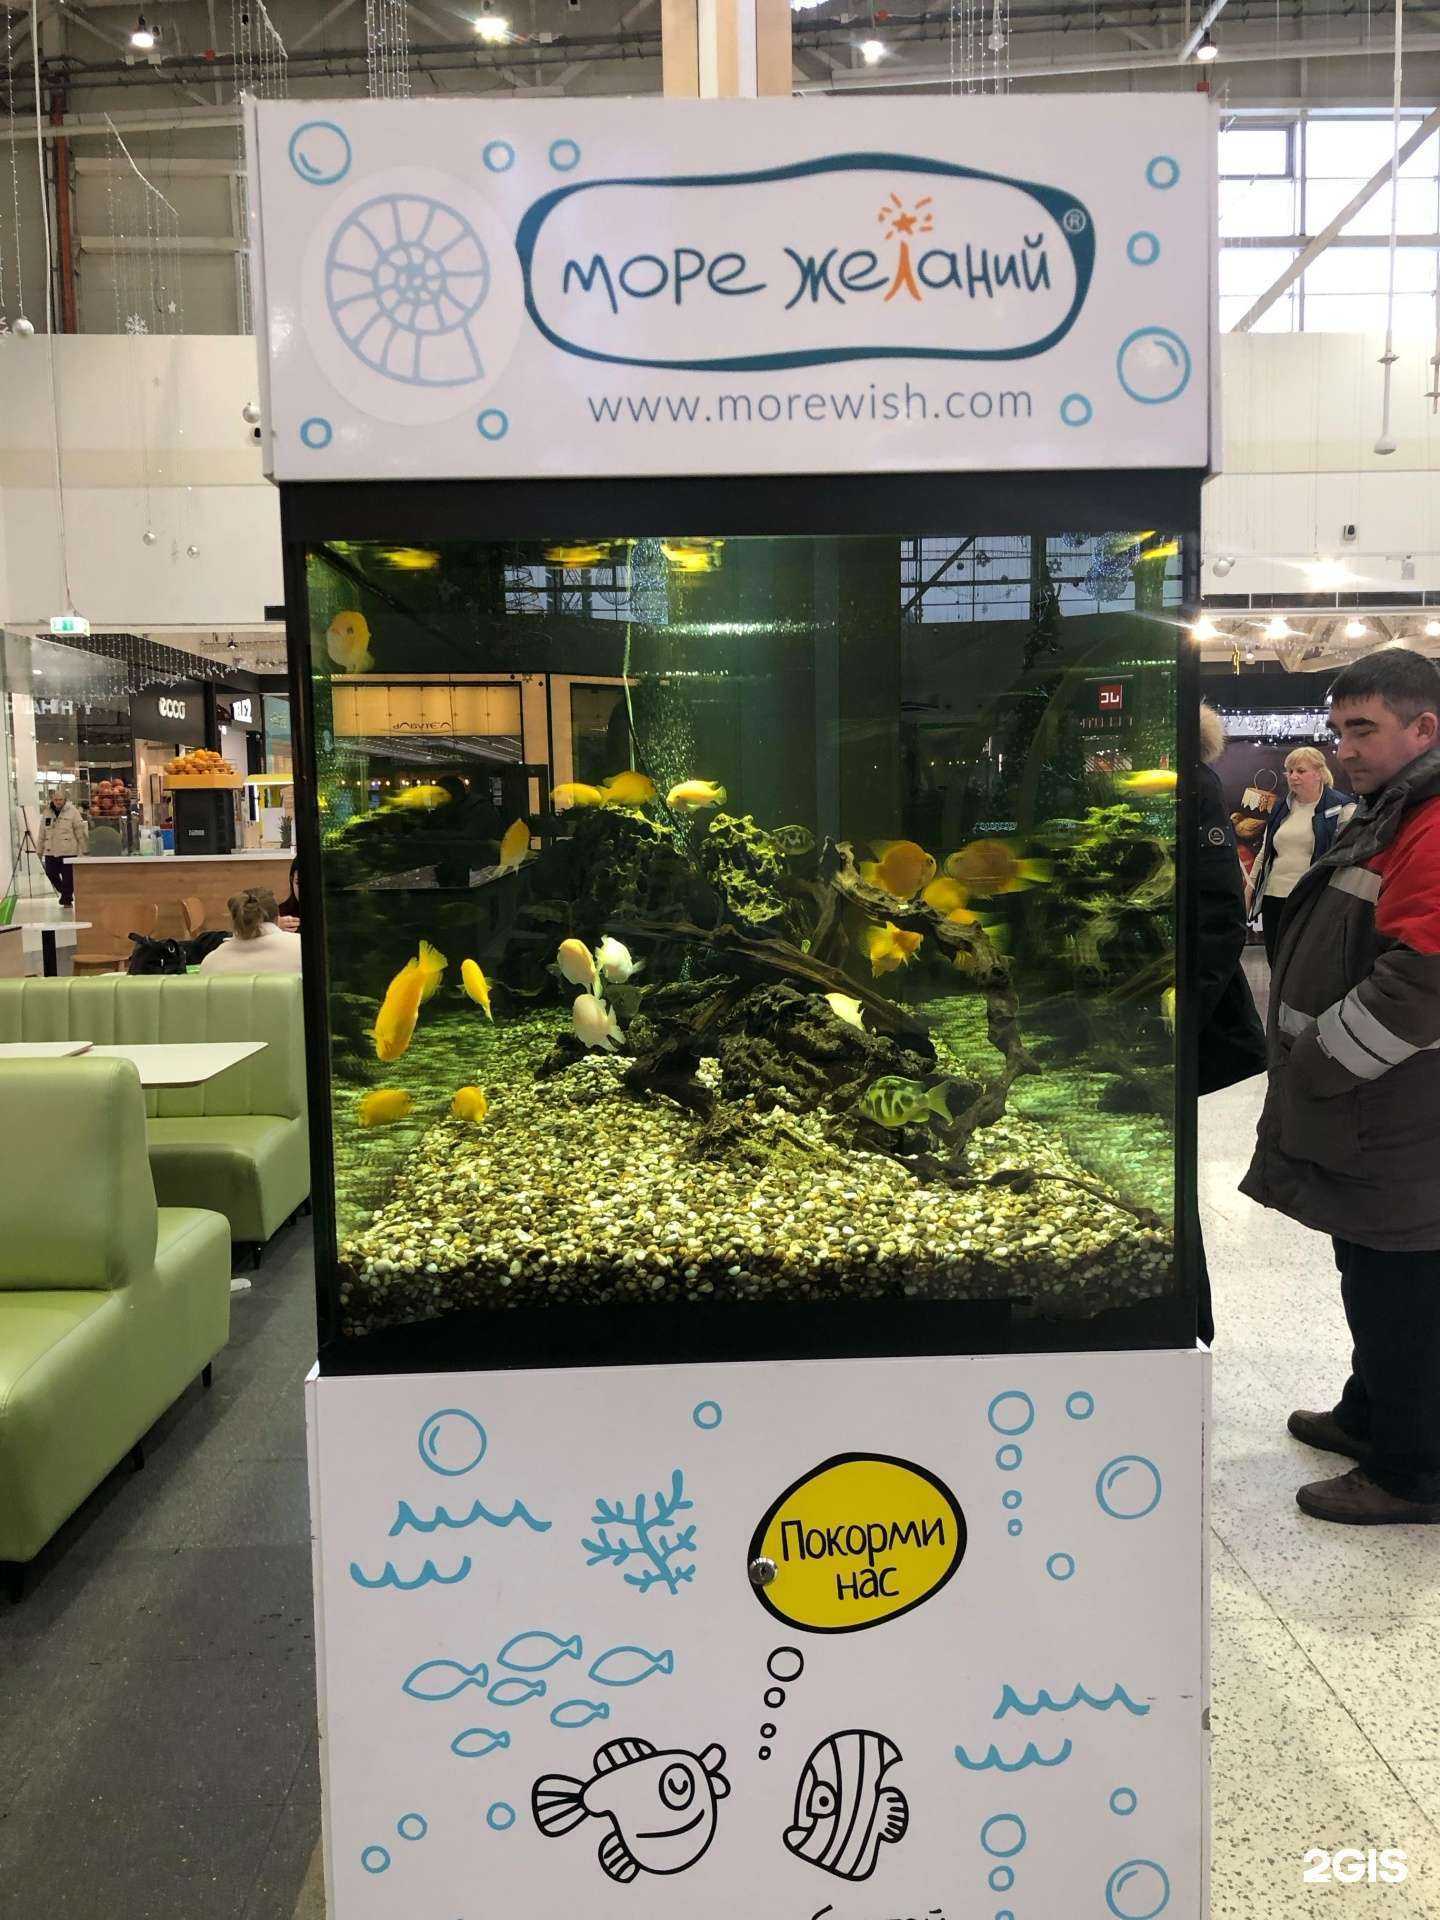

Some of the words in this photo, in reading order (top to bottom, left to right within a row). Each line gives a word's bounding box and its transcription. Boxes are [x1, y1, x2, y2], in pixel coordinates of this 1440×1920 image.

[587, 382, 1034, 423] www.morewish.com
[780, 1517, 946, 1567] Покорми
[836, 1567, 900, 1601] нас
